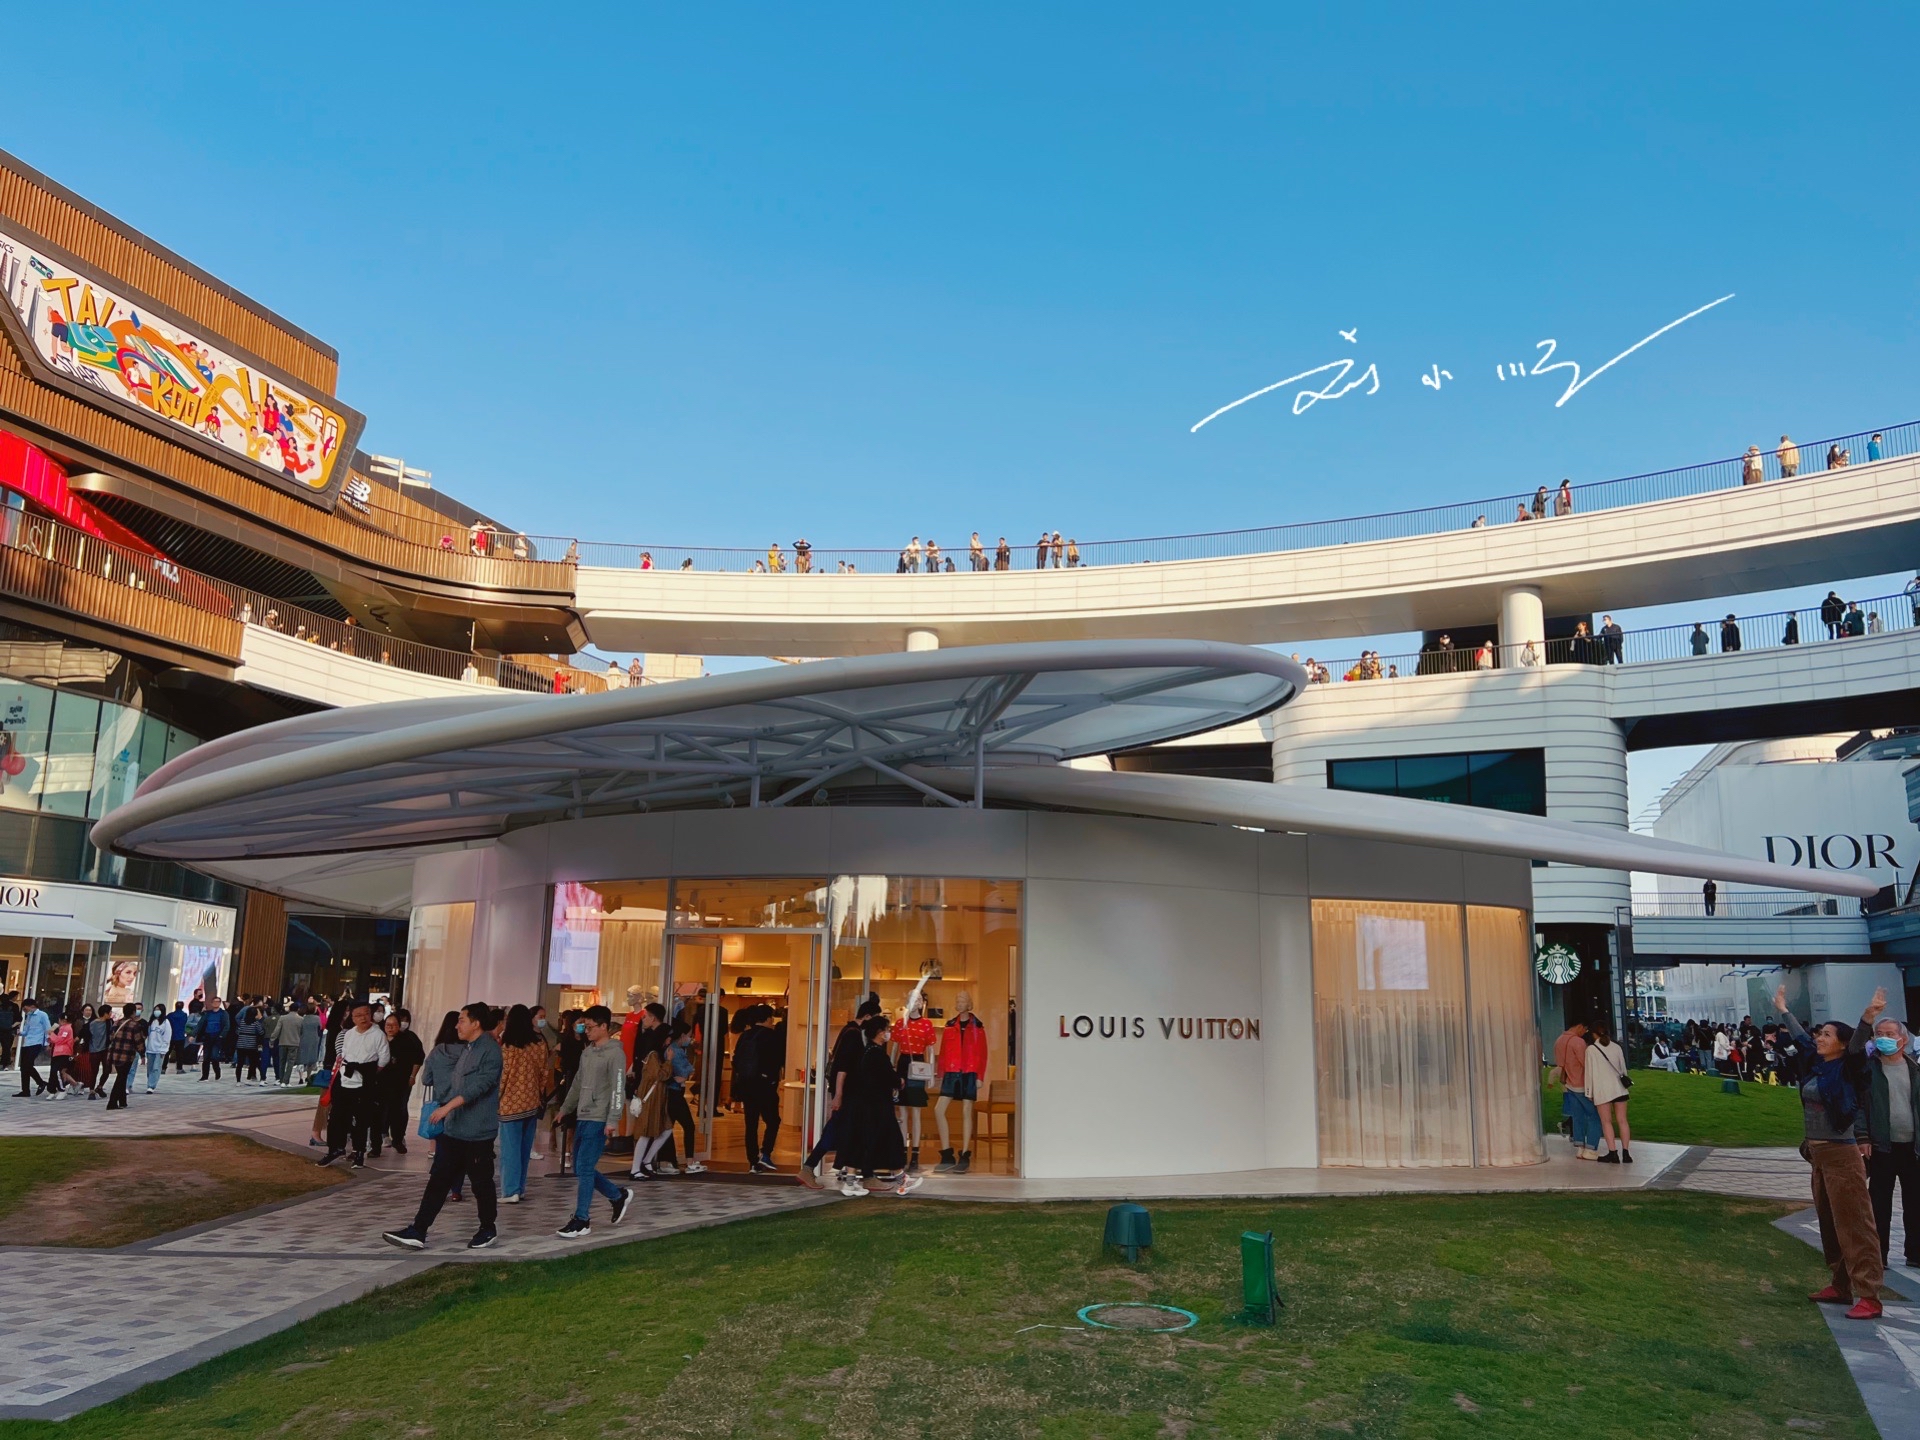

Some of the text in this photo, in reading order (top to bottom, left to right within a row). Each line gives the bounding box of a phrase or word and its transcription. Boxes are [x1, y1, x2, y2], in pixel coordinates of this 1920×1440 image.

[40, 278, 117, 328] TAI
[150, 370, 202, 428] KOO
[1761, 833, 1904, 870] DIOR
[0, 885, 40, 909] IOR
[195, 909, 219, 929] DIOR
[1059, 1015, 1260, 1041] LOUIS VUITTON
